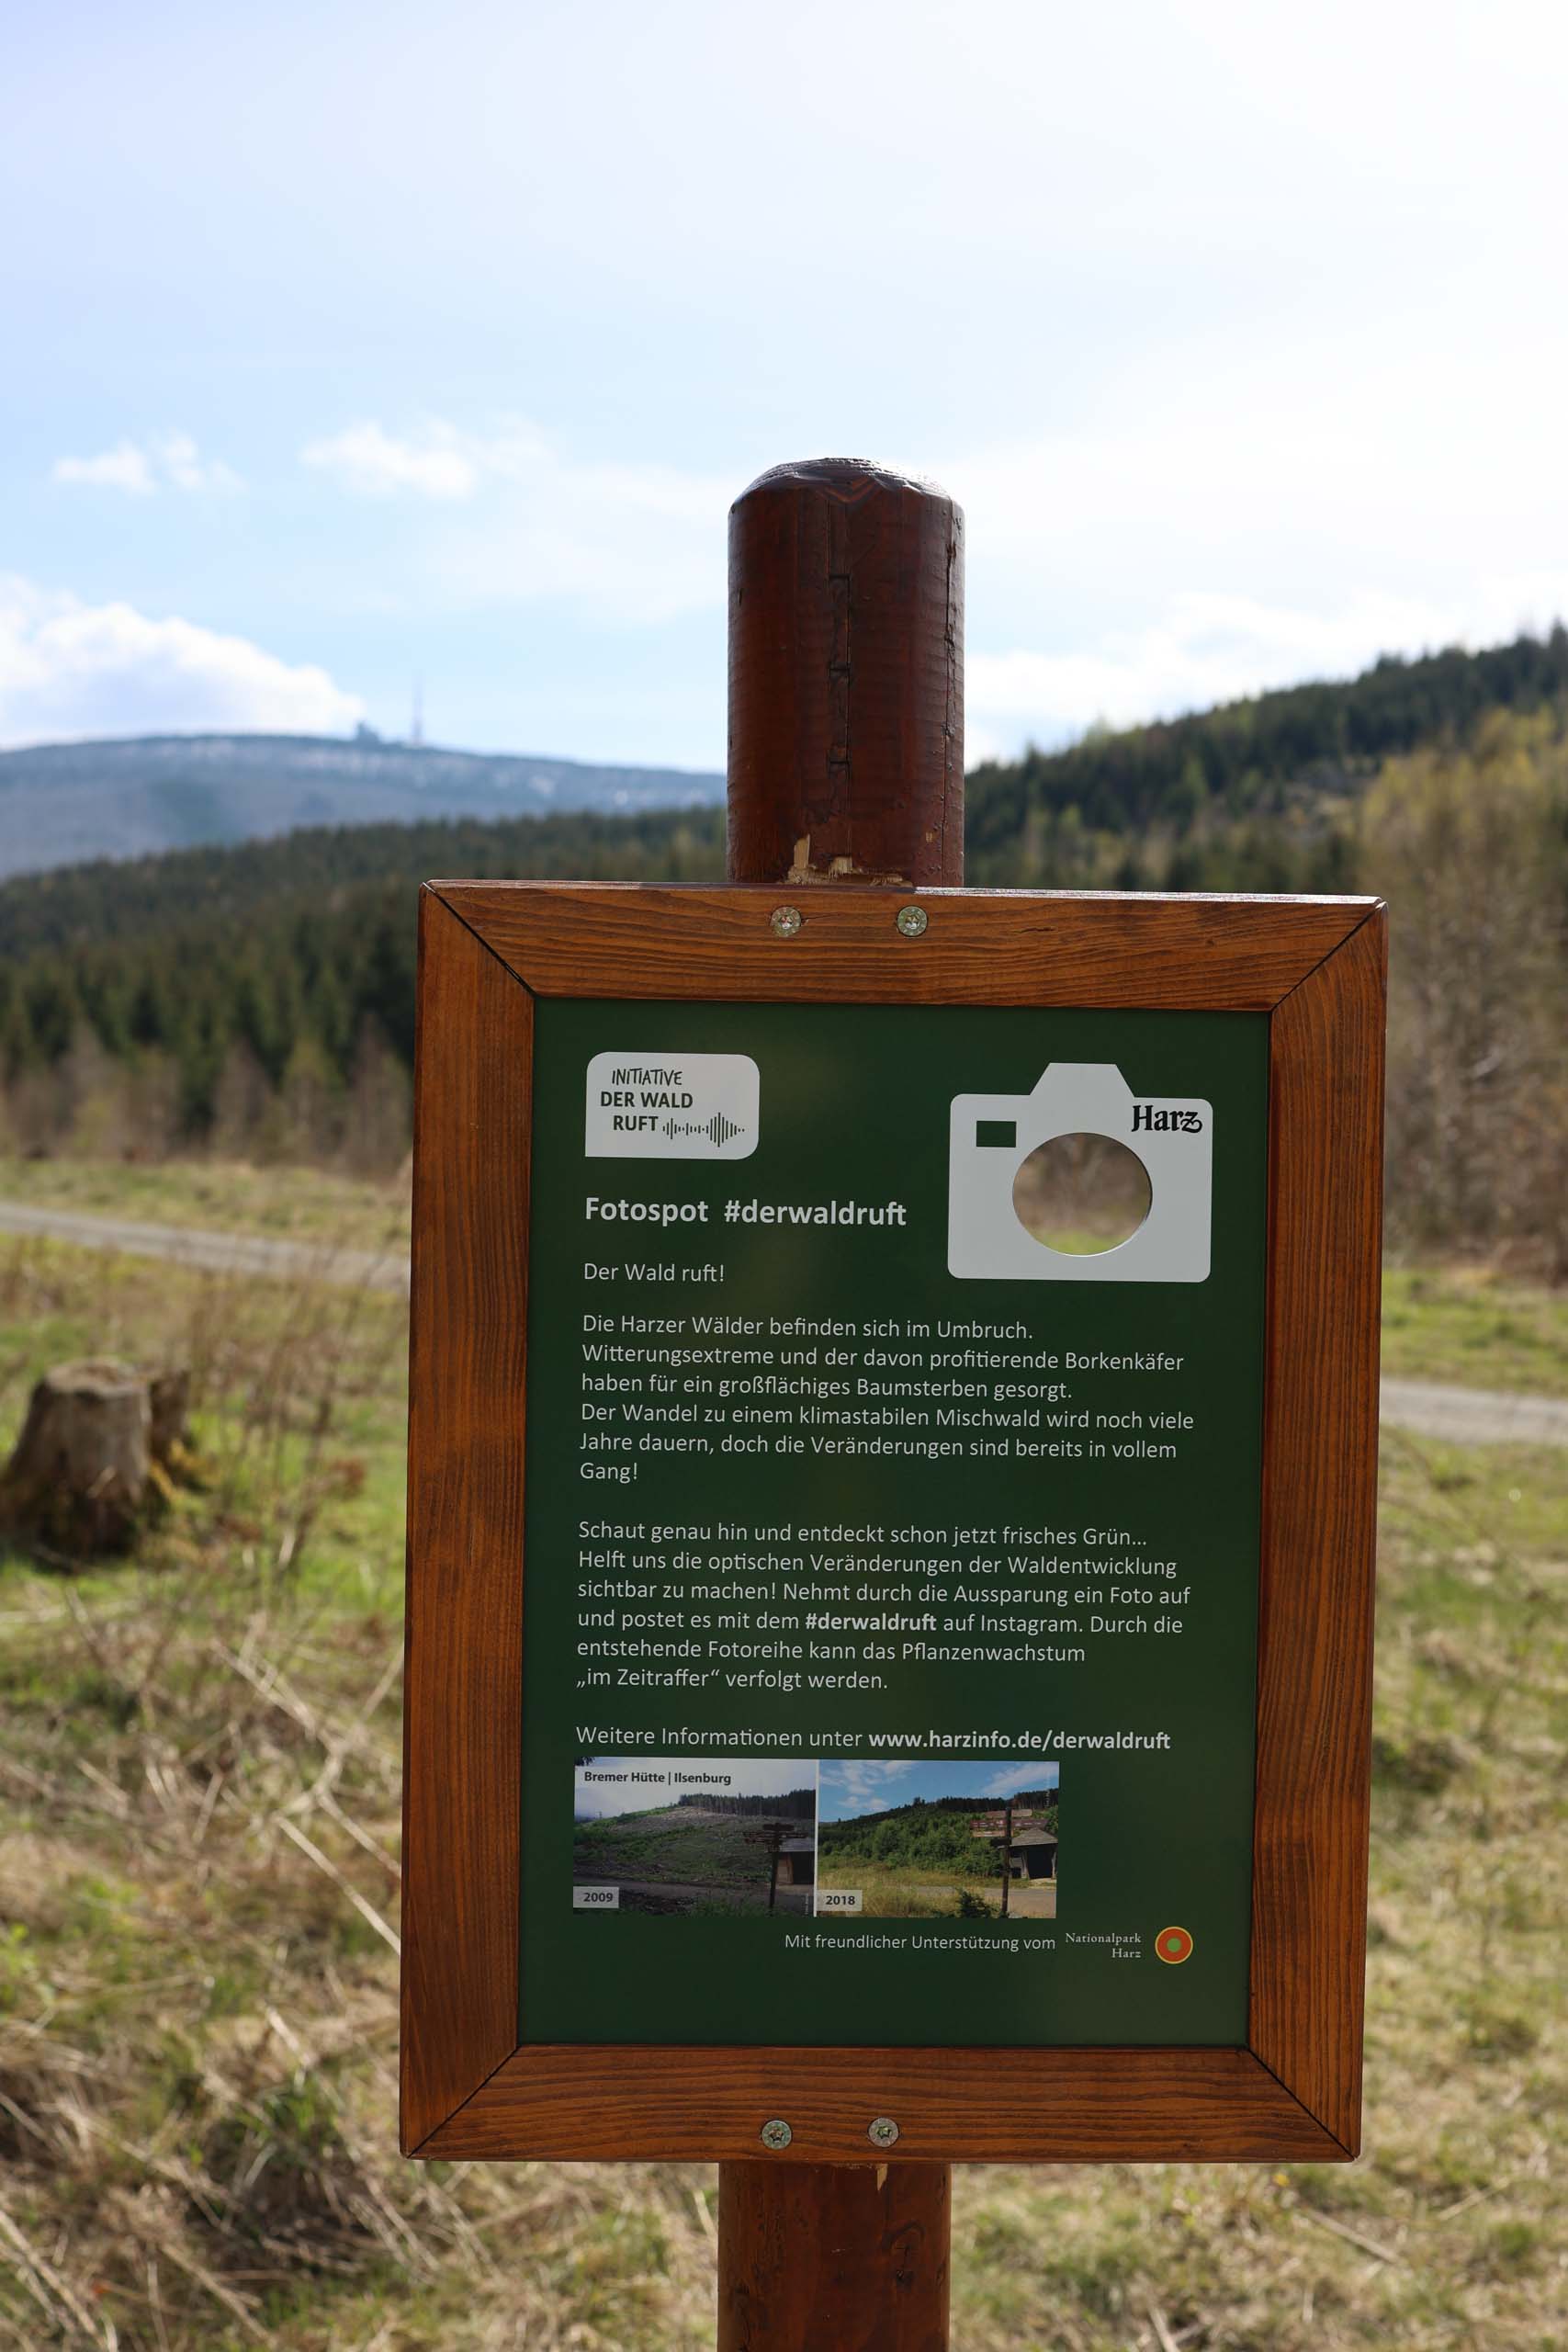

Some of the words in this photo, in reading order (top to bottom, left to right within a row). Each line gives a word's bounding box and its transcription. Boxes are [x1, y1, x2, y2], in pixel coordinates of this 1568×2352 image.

[611, 1067, 683, 1087] INITIATIVE
[600, 1091, 636, 1108] DER
[639, 1091, 694, 1109] WALD
[613, 1114, 660, 1132] RUFT
[1131, 1104, 1203, 1134] Harz
[585, 1197, 709, 1227] Fotospot
[724, 1198, 907, 1227] #derwaldruft
[584, 1262, 619, 1281] Der
[624, 1262, 675, 1282] Wald
[682, 1263, 724, 1283] ruft!
[583, 1315, 615, 1332] Die
[621, 1315, 686, 1333] Harzer
[692, 1316, 764, 1335] Wälder
[770, 1317, 856, 1337] befinden
[863, 1318, 900, 1337] sich
[907, 1319, 930, 1338] im
[937, 1319, 1032, 1339] Umbruch.
[581, 1344, 774, 1367] Witterungsextreme
[781, 1347, 818, 1365] und
[824, 1347, 858, 1366] der
[863, 1348, 923, 1367] davon
[930, 1349, 1059, 1372] profitierende
[1066, 1351, 1184, 1371] Borkenkäfer
[581, 1373, 642, 1392] haben
[649, 1374, 678, 1393] für
[683, 1374, 713, 1393] ein
[718, 1375, 851, 1399] großflächiges
[857, 1378, 987, 1397] Baumsterben
[993, 1382, 1072, 1403] gesorgt.
[581, 1403, 616, 1421] Der
[622, 1403, 697, 1422] Wandel
[704, 1408, 726, 1423] zu
[732, 1406, 793, 1424] einem
[799, 1406, 929, 1426] klimastabilen
[936, 1408, 1040, 1428] Mischwald
[1046, 1409, 1089, 1428] wird
[1096, 1410, 1143, 1429] noch
[1148, 1410, 1194, 1430] viele
[579, 1431, 633, 1451] Jahre
[638, 1432, 714, 1455] dauern,
[721, 1433, 768, 1453] doch
[774, 1434, 805, 1453] die
[810, 1436, 963, 1460] Veränderungen
[969, 1438, 1009, 1456] sind
[1016, 1438, 1083, 1457] bereits
[1089, 1440, 1106, 1457] in
[1111, 1440, 1177, 1458] vollem
[580, 1462, 637, 1485] Gang!
[579, 1521, 646, 1539] Schaut
[650, 1526, 711, 1544] genau
[717, 1521, 748, 1541] hin
[754, 1522, 791, 1542] und
[797, 1523, 885, 1543] entdeckt
[890, 1524, 947, 1544] schon
[952, 1526, 997, 1547] jetzt
[1002, 1526, 1077, 1545] frisches
[579, 1550, 626, 1568] Helft
[632, 1555, 667, 1569] uns
[672, 1551, 702, 1569] die
[708, 1552, 804, 1574] optischen
[809, 1554, 962, 1577] Veränderungen
[968, 1555, 1002, 1574] der
[1007, 1555, 1177, 1579] Waldentwicklung
[578, 1579, 658, 1598] sichtbar
[662, 1585, 684, 1599] zu
[691, 1581, 775, 1600] machen!
[784, 1582, 851, 1600] Nehmt
[856, 1583, 912, 1601] durch
[918, 1583, 948, 1602] die
[953, 1585, 1068, 1608] Aussparung
[1074, 1586, 1103, 1603] ein
[1111, 1587, 1154, 1604] Foto
[1159, 1586, 1191, 1604] auf
[578, 1609, 615, 1627] und
[622, 1611, 684, 1632] postet
[690, 1614, 712, 1628] es
[717, 1611, 750, 1629] mit
[756, 1611, 799, 1629] dem
[805, 1611, 937, 1631] #derwaldruft
[943, 1613, 976, 1632] auf
[981, 1614, 1083, 1636] Instagram.
[1090, 1615, 1147, 1634] Durch
[1154, 1615, 1183, 1634] die
[577, 1638, 702, 1657] entstehende
[708, 1640, 803, 1659] Fotoreihe
[809, 1640, 856, 1659] kann
[863, 1641, 896, 1660] das
[902, 1642, 1085, 1662] Pflanzenwachstum
[725, 1669, 802, 1692] verfolgt
[807, 1670, 887, 1689] werden.
[576, 1726, 655, 1745] Weitere
[662, 1726, 802, 1747] Informationen
[809, 1731, 863, 1747] unter
[868, 1729, 1171, 1752] www.harzinfo.de/derwaldruft
[583, 1770, 629, 1782] Bremer
[630, 1771, 666, 1783] Hütte
[673, 1771, 732, 1787] Ilsenburg
[582, 1892, 614, 1903] 2009
[825, 1894, 856, 1905] 2018
[785, 1934, 811, 1949] Mit
[815, 1934, 908, 1949] freundlicher
[912, 1935, 1020, 1952] Unterstützung
[1022, 1939, 1055, 1950] vom
[1065, 1932, 1142, 1946] Nationalpark
[1111, 1947, 1142, 1959] Harz
